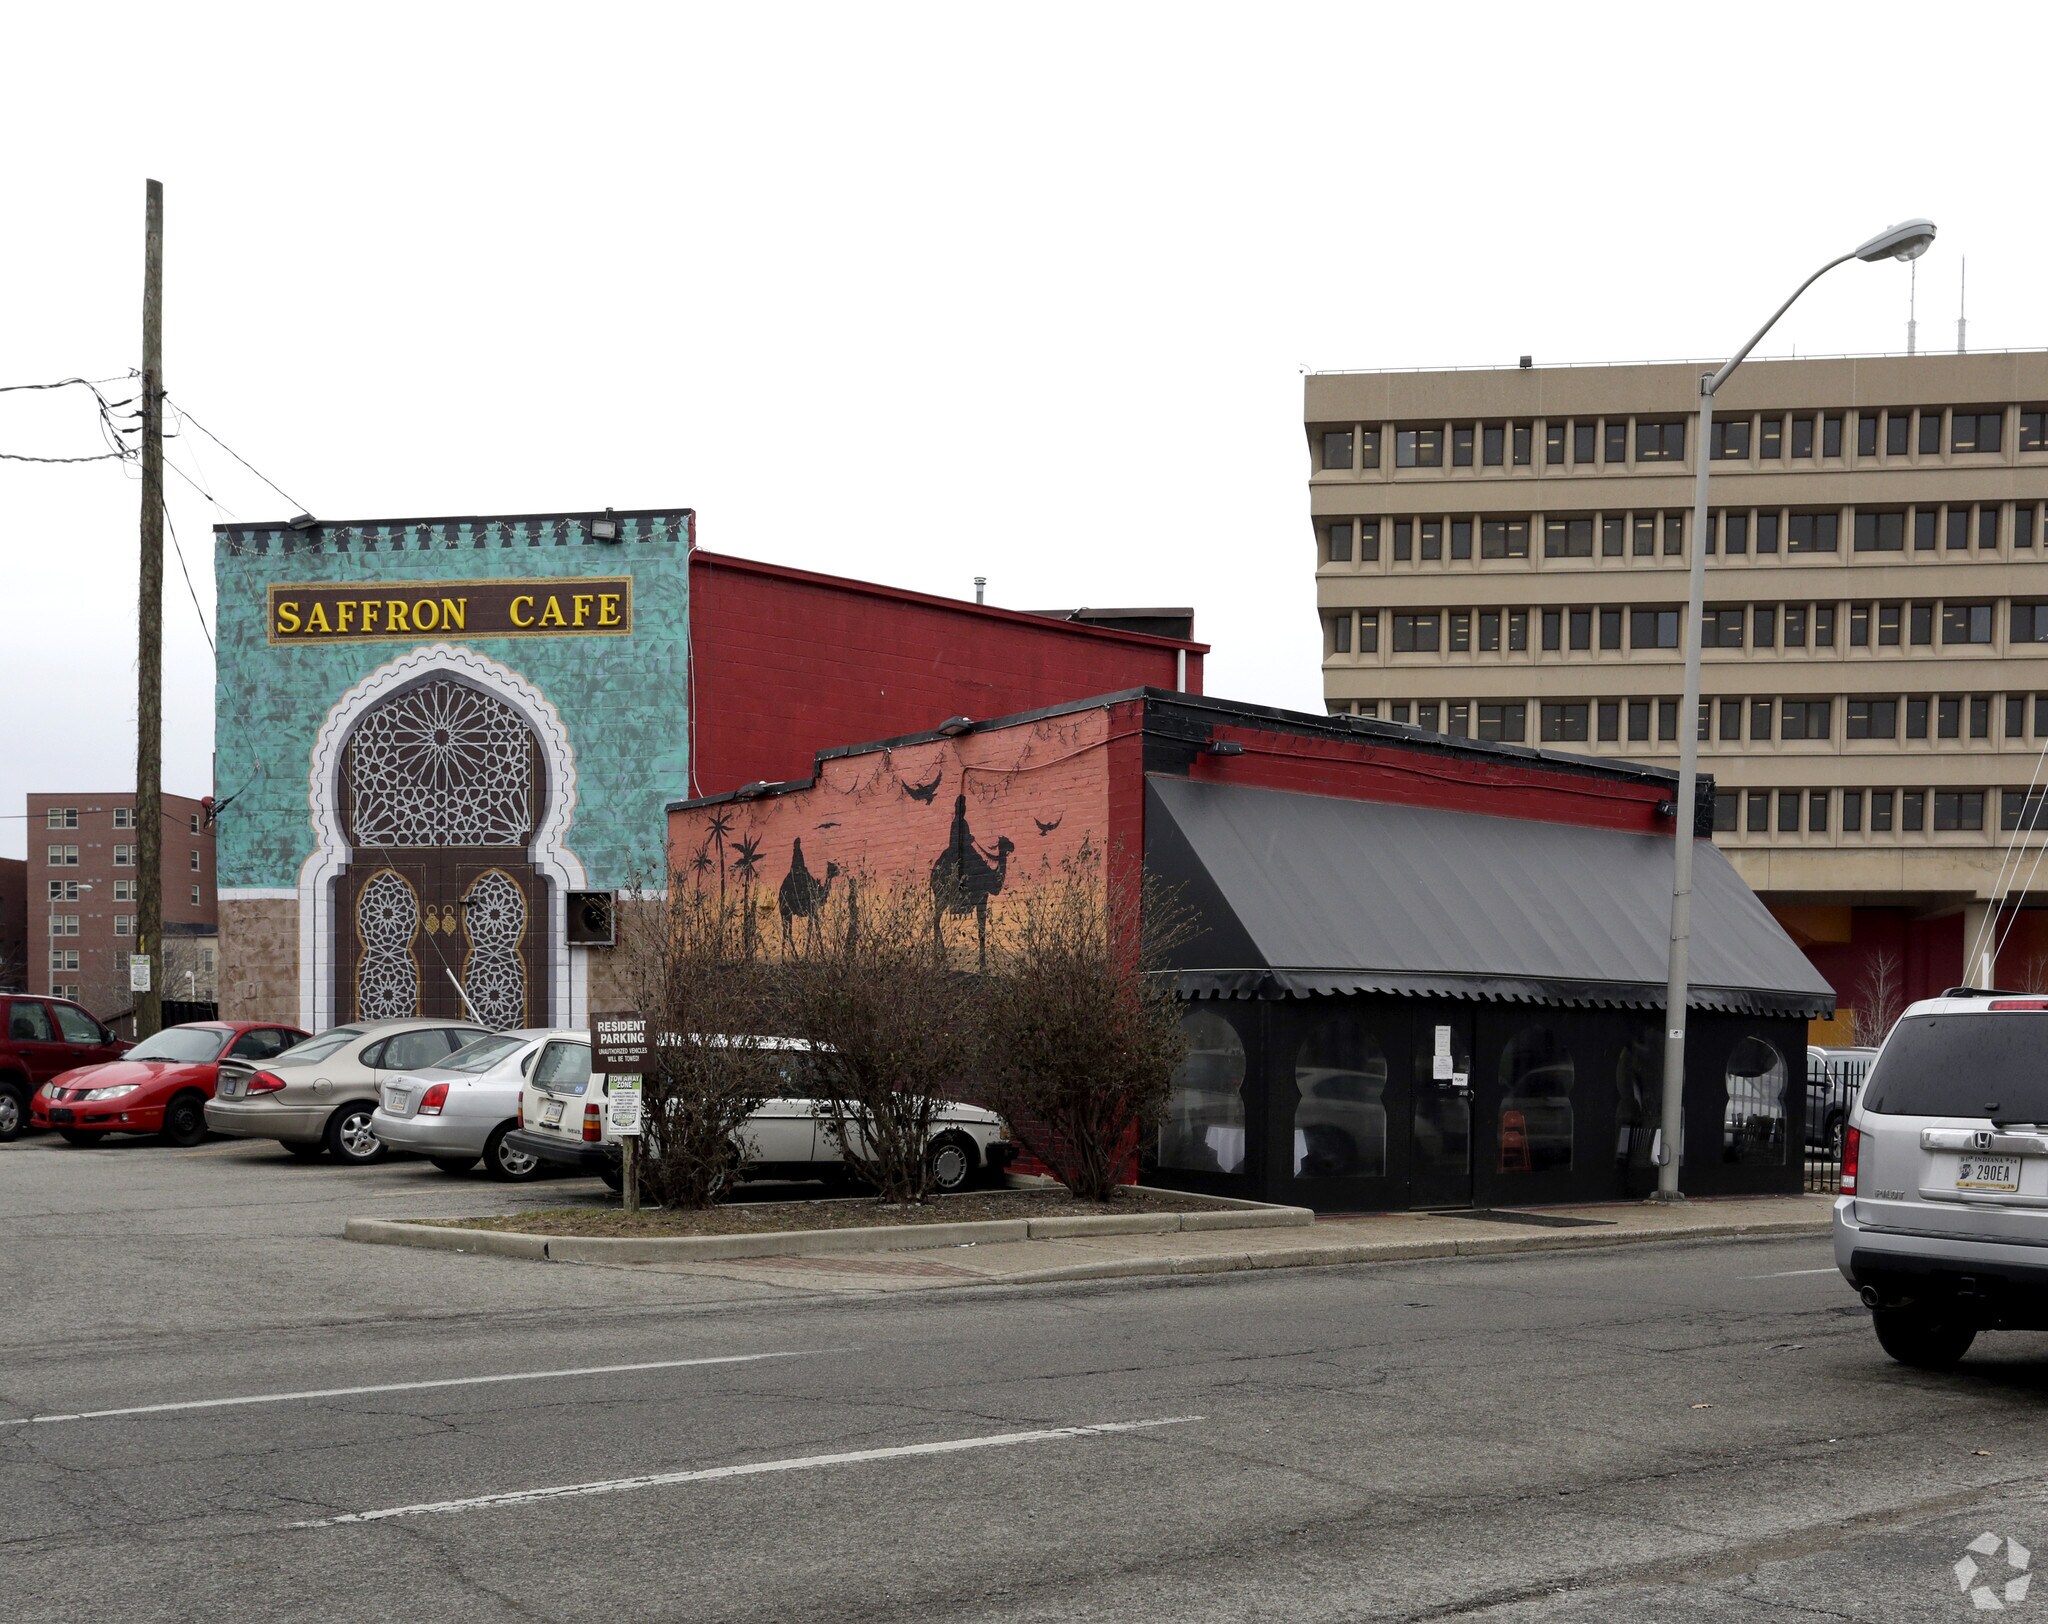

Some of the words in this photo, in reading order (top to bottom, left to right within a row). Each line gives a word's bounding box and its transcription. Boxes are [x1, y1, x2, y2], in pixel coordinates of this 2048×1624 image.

[278, 598, 468, 634] SAFFRON
[509, 593, 622, 628] CAFE
[597, 1020, 647, 1032] RESIDENT
[600, 1032, 645, 1044] PARKING
[598, 1047, 629, 1055] UNAUTHORIZED
[616, 1081, 633, 1089] ZONE
[1976, 1164, 2010, 1182] 290EA
[1874, 1188, 1905, 1201] PILOT
